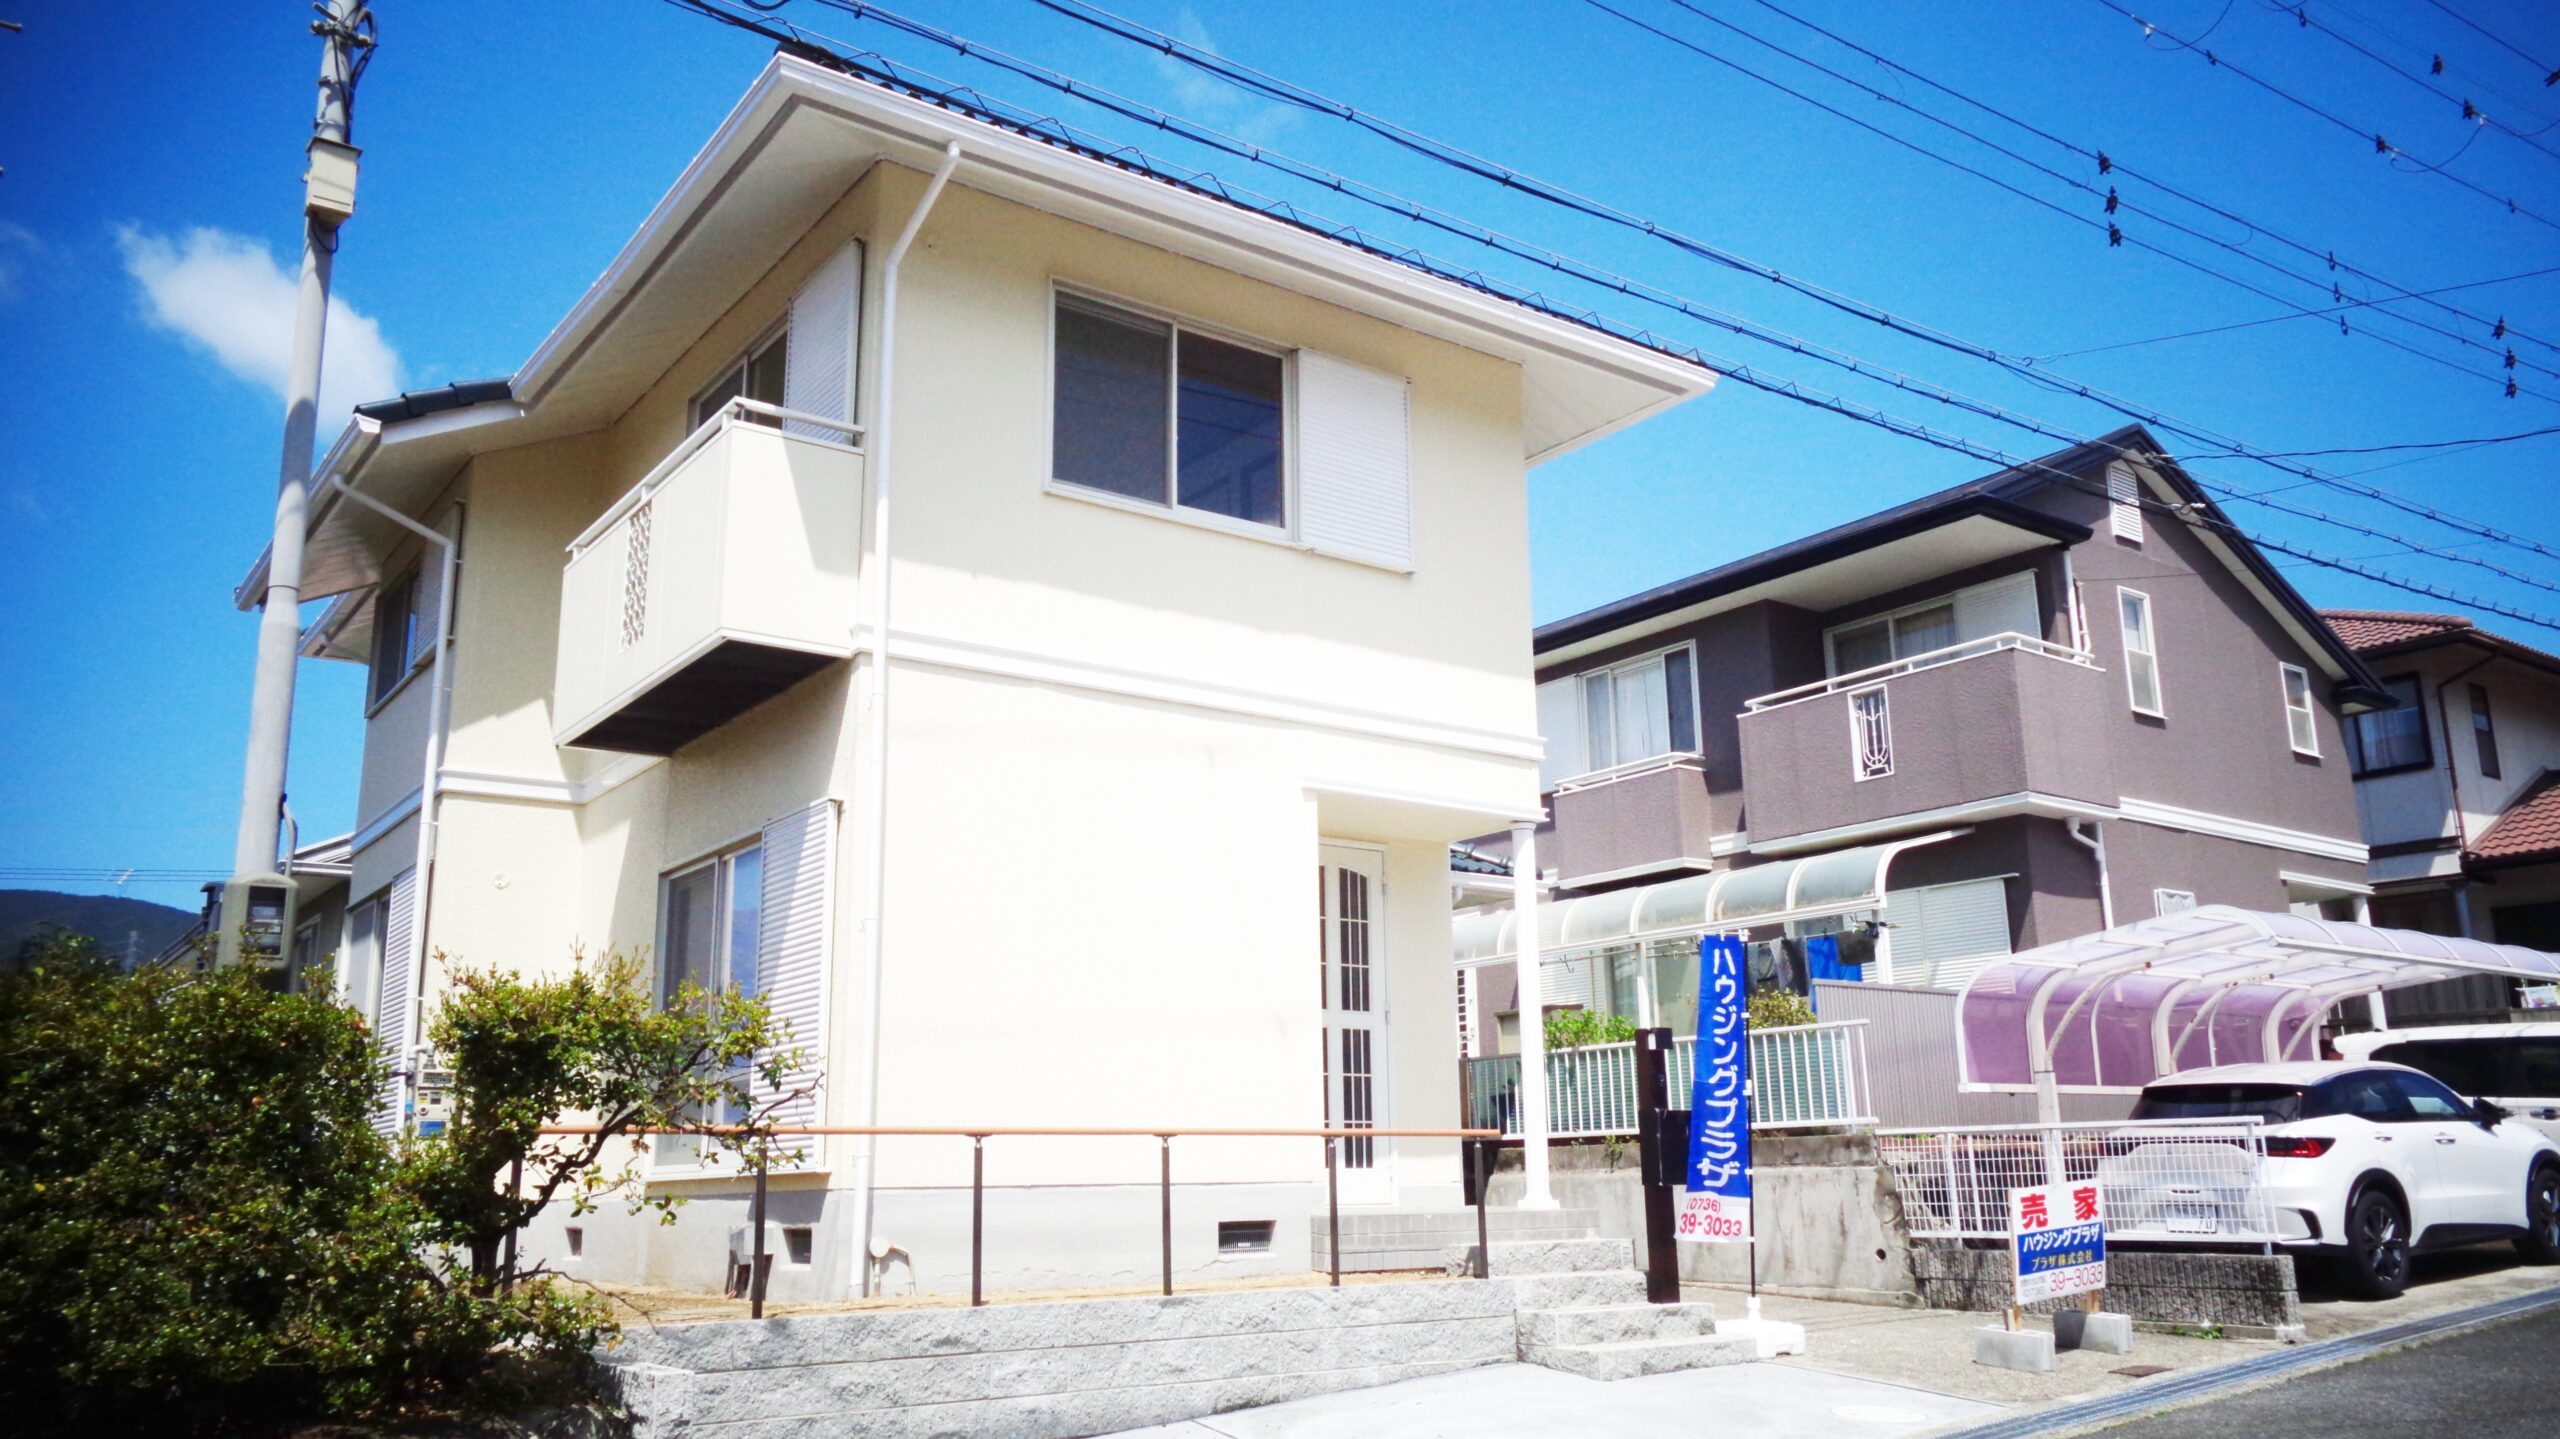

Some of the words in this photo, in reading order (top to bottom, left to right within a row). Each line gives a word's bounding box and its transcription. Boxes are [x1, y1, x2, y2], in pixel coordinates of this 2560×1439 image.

[1697, 948, 1740, 1188] ハウジングプラザ
[1687, 1197, 1721, 1214] (0736)
[1679, 1212, 1742, 1236] 39-3033
[2050, 1264, 2103, 1292] 39-3033
